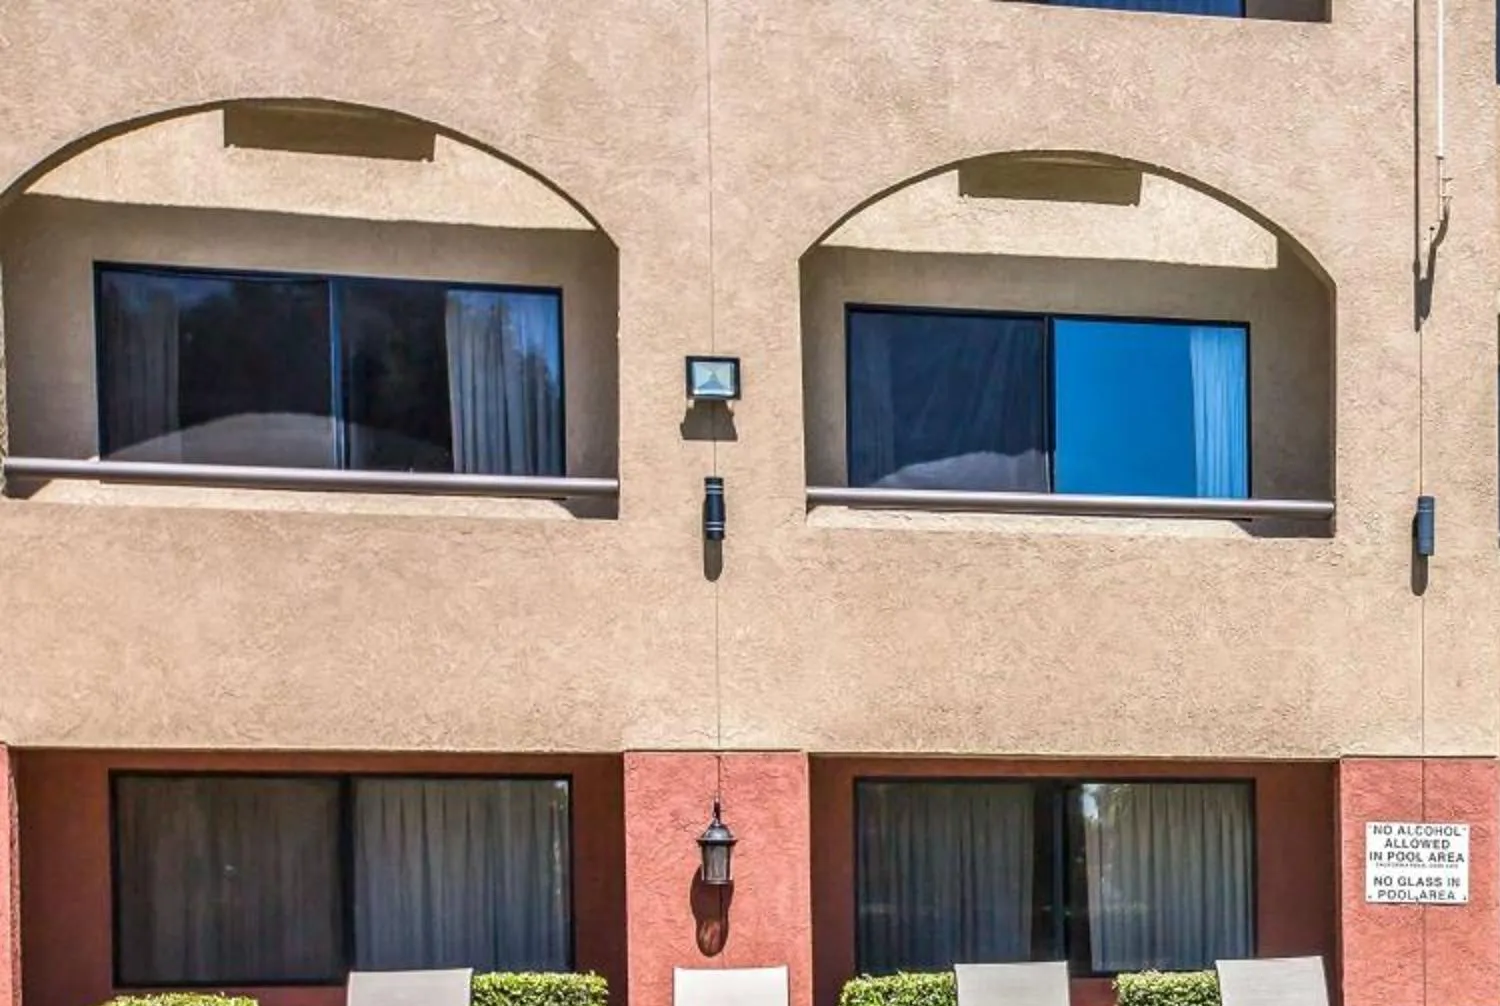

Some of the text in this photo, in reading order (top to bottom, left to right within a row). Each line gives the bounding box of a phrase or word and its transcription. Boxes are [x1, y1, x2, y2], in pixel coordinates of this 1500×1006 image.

[1373, 825, 1462, 837] NO ALCOHOL
[1384, 838, 1451, 849] ALLOWED
[1369, 851, 1465, 863] IN POOL AREA
[1373, 876, 1460, 888] NO GLASS IN
[1377, 890, 1456, 900] POOL AREA
